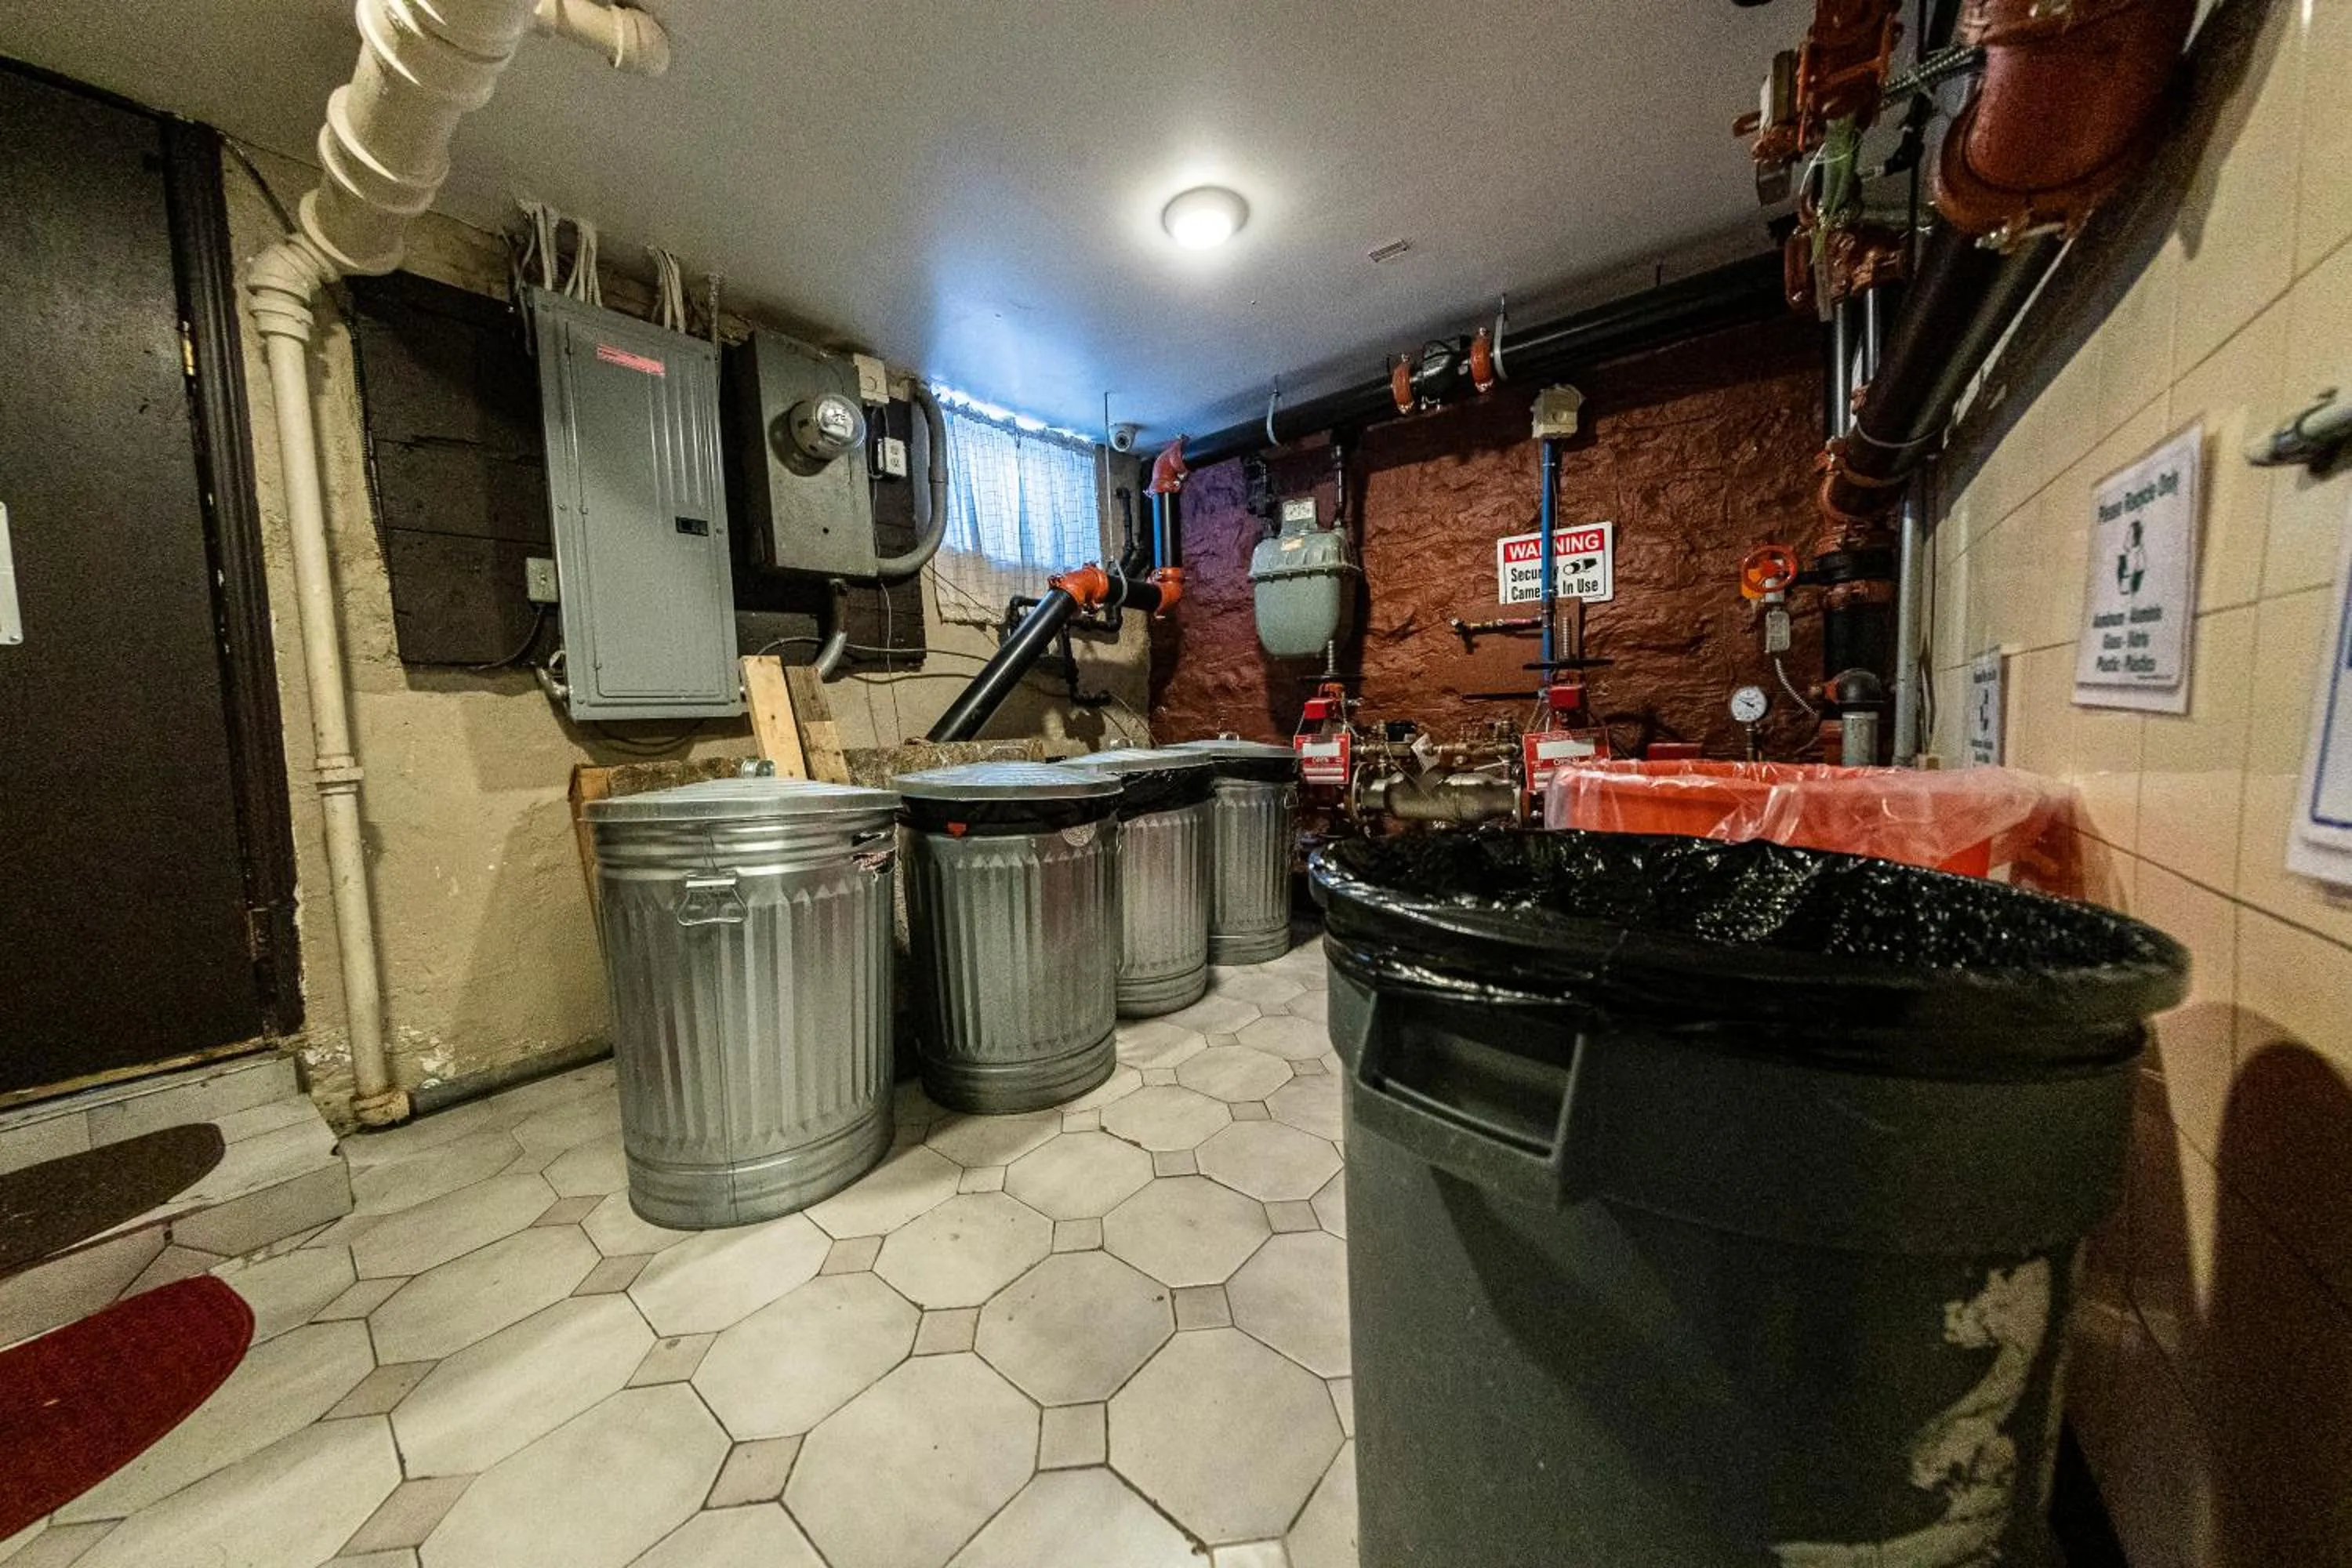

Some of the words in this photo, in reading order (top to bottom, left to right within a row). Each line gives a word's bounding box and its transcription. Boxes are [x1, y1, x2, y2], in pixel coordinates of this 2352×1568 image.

[1508, 533, 1599, 561] WANING
[1512, 584, 1559, 601] Cames
[1563, 580, 1573, 594] In
[1577, 578, 1599, 593] Use
